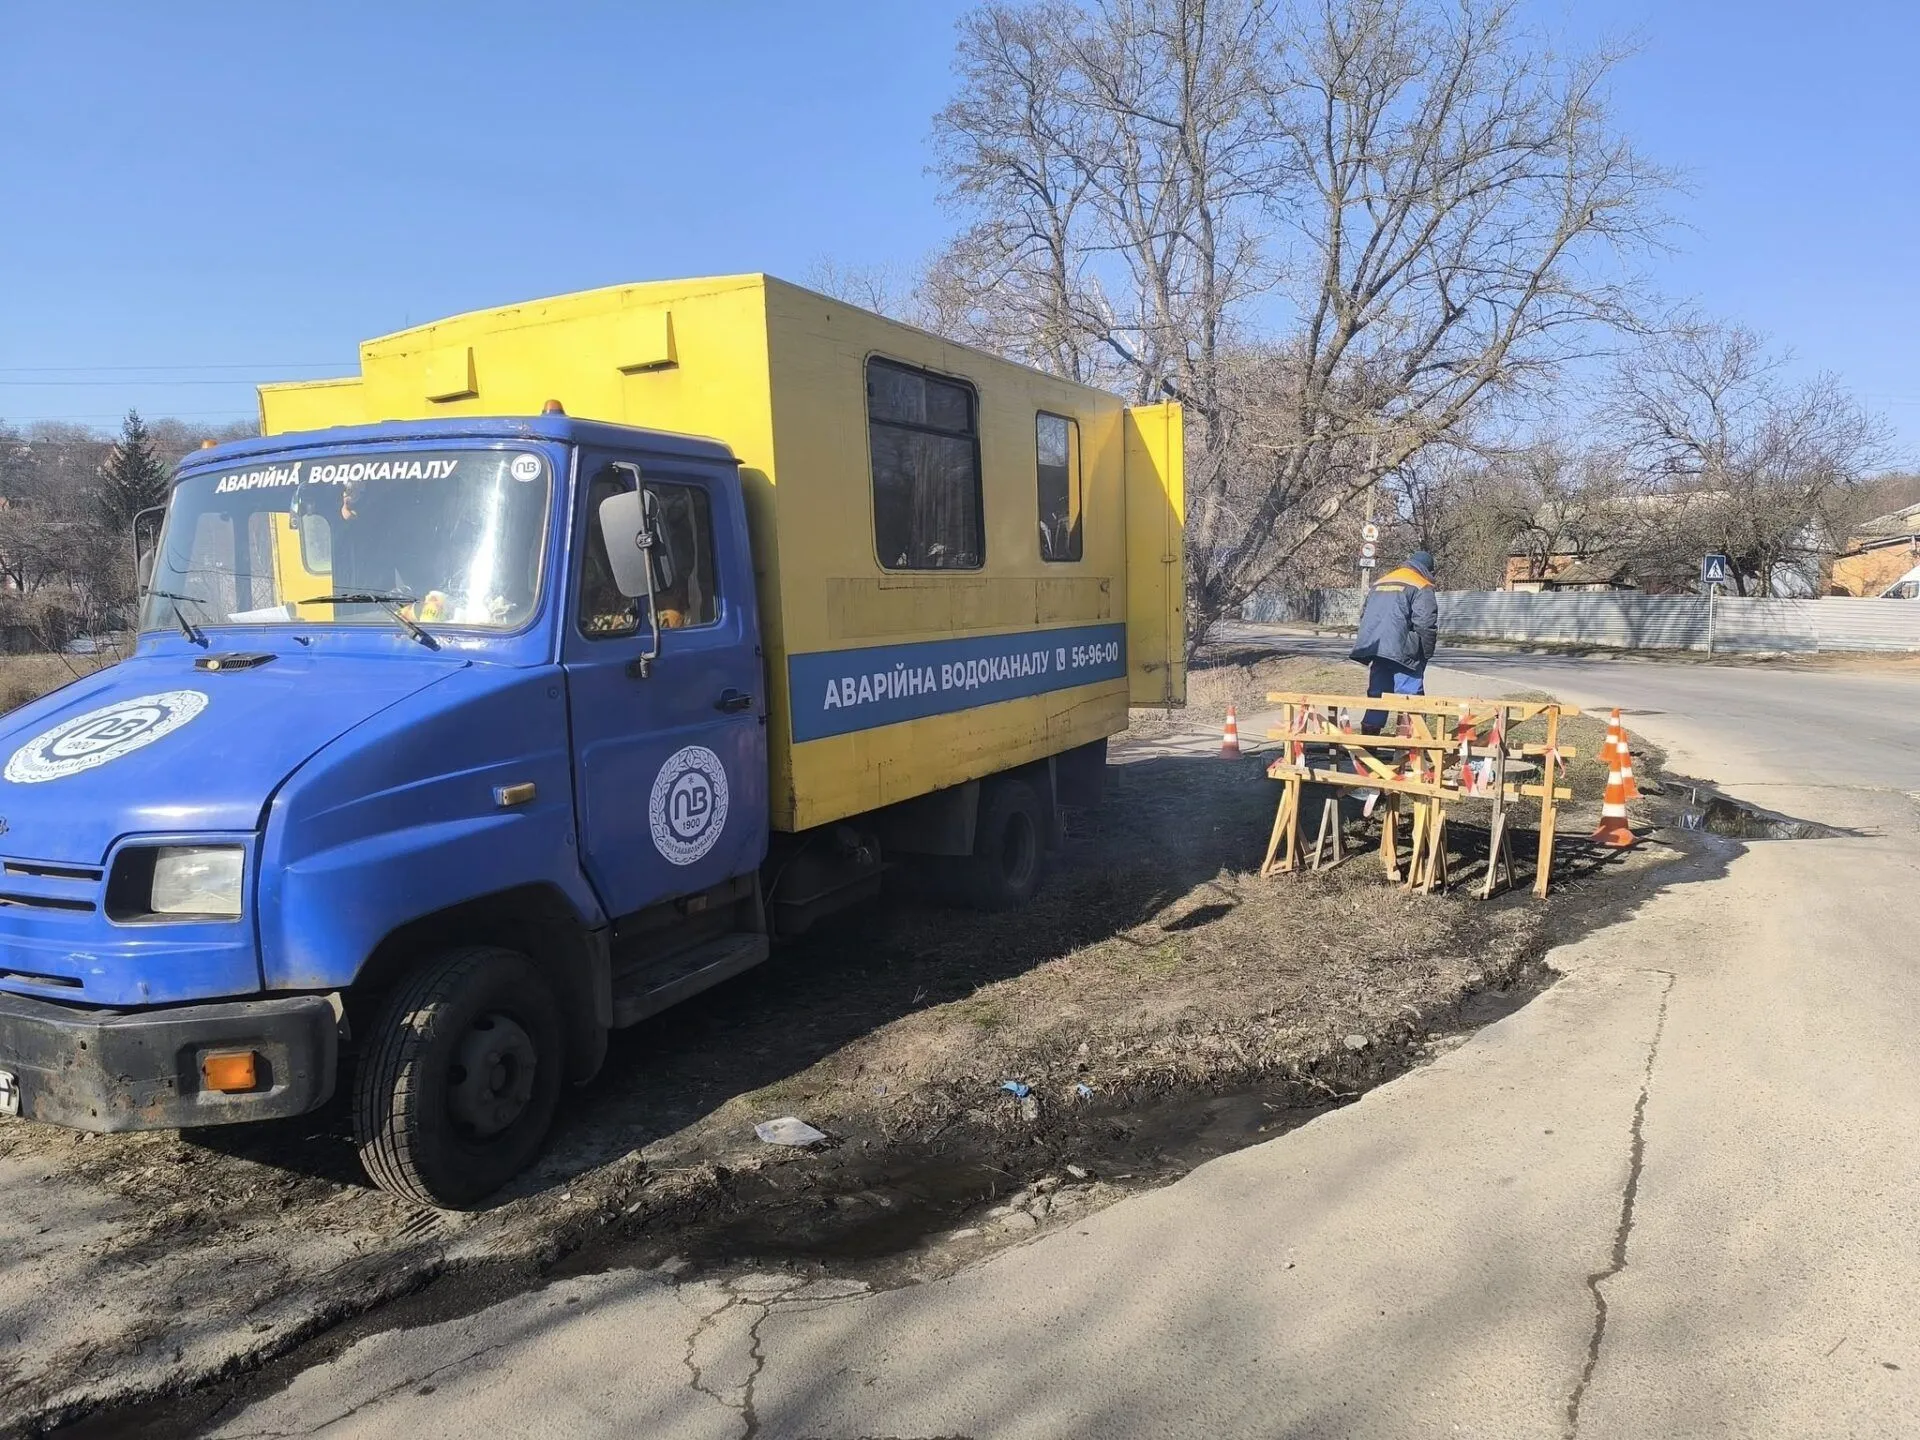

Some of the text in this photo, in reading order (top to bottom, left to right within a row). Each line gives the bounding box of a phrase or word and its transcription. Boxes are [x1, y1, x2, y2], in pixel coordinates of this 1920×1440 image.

[214, 460, 458, 493] АВАРІЙНА ВОДОКАНАЛУ
[823, 642, 1118, 710] АВАРІЙНА ВОДОКАНАЛУ 56-96-00
[682, 818, 701, 831] 1900
